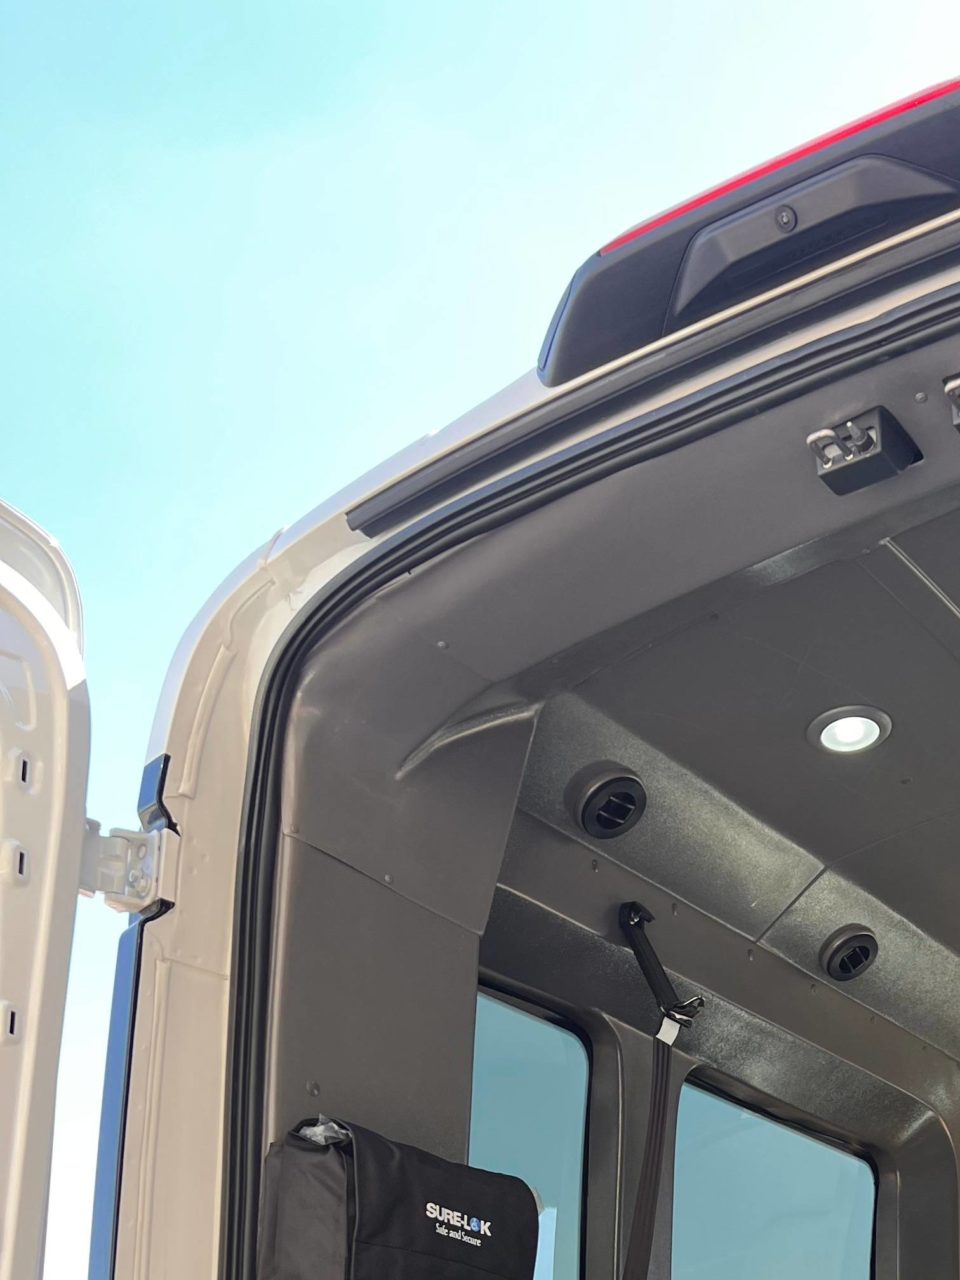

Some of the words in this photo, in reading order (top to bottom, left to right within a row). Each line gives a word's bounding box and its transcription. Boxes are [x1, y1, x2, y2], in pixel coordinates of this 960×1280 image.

[435, 1223, 449, 1236] Safe
[449, 1230, 462, 1240] and
[462, 1231, 482, 1247] Secure
